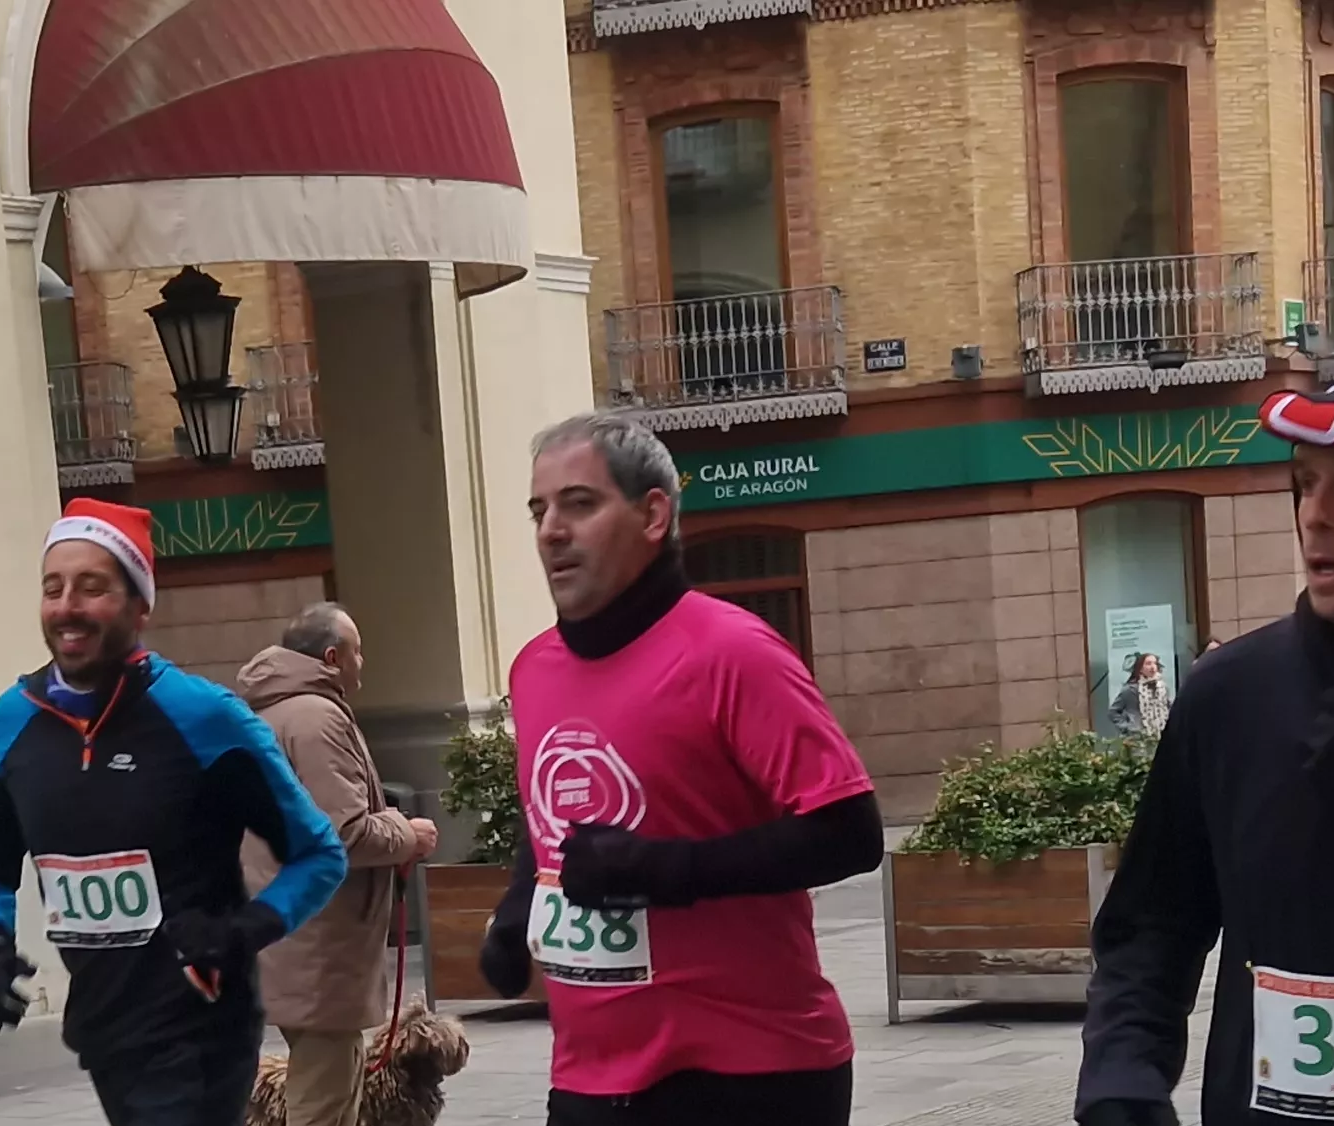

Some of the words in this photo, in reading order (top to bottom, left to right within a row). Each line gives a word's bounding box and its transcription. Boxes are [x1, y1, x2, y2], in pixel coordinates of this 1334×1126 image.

[700, 462, 749, 482] CAJA
[754, 455, 820, 477] RURAL
[715, 485, 736, 499] DE
[739, 477, 808, 496] ARAGÓN
[56, 871, 149, 921] 100
[542, 892, 638, 953] 238
